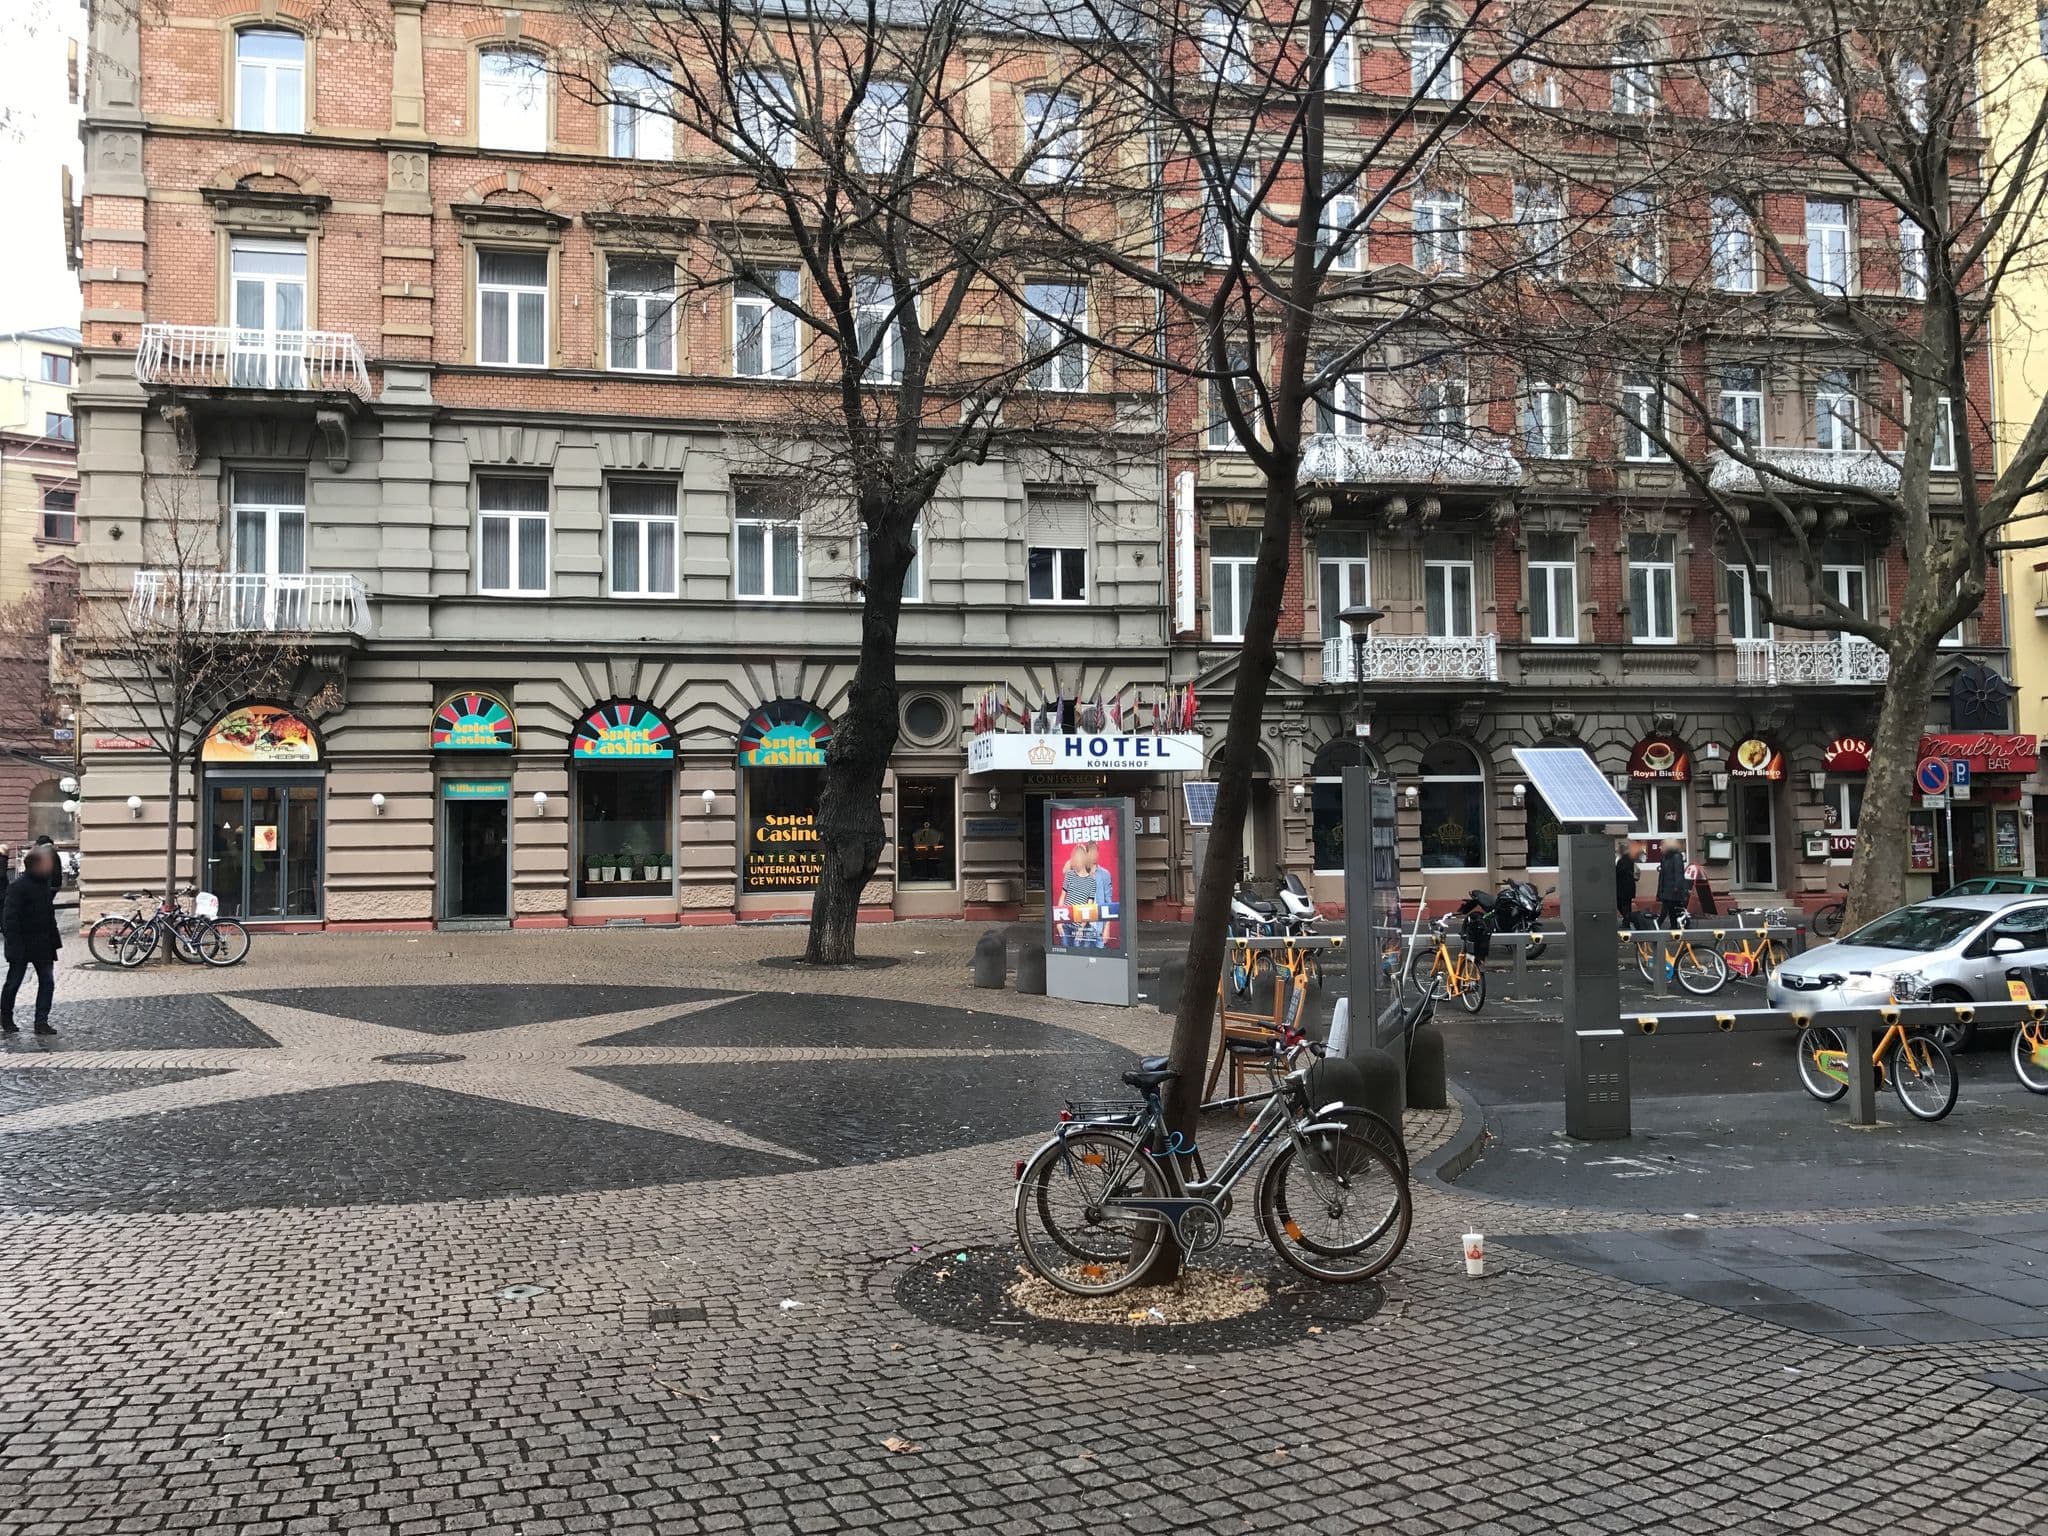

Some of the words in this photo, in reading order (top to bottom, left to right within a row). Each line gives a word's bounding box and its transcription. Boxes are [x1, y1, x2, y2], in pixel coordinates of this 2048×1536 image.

[453, 722, 495, 734] Spiel
[599, 726, 650, 741] Spiel
[444, 735, 502, 744] Casino
[760, 735, 816, 749] Spiel
[583, 741, 663, 755] Casino
[1065, 737, 1170, 757] HOTEL
[1087, 758, 1149, 768] KÖNIGSHOF
[1988, 759, 2011, 770] BAR
[1732, 769, 1755, 777] Royal
[765, 815, 813, 826] Spiel
[1056, 816, 1083, 829] LASST
[1084, 815, 1103, 826] UNS
[1061, 825, 1110, 845] LIEBEN
[1053, 905, 1119, 921] RTL
